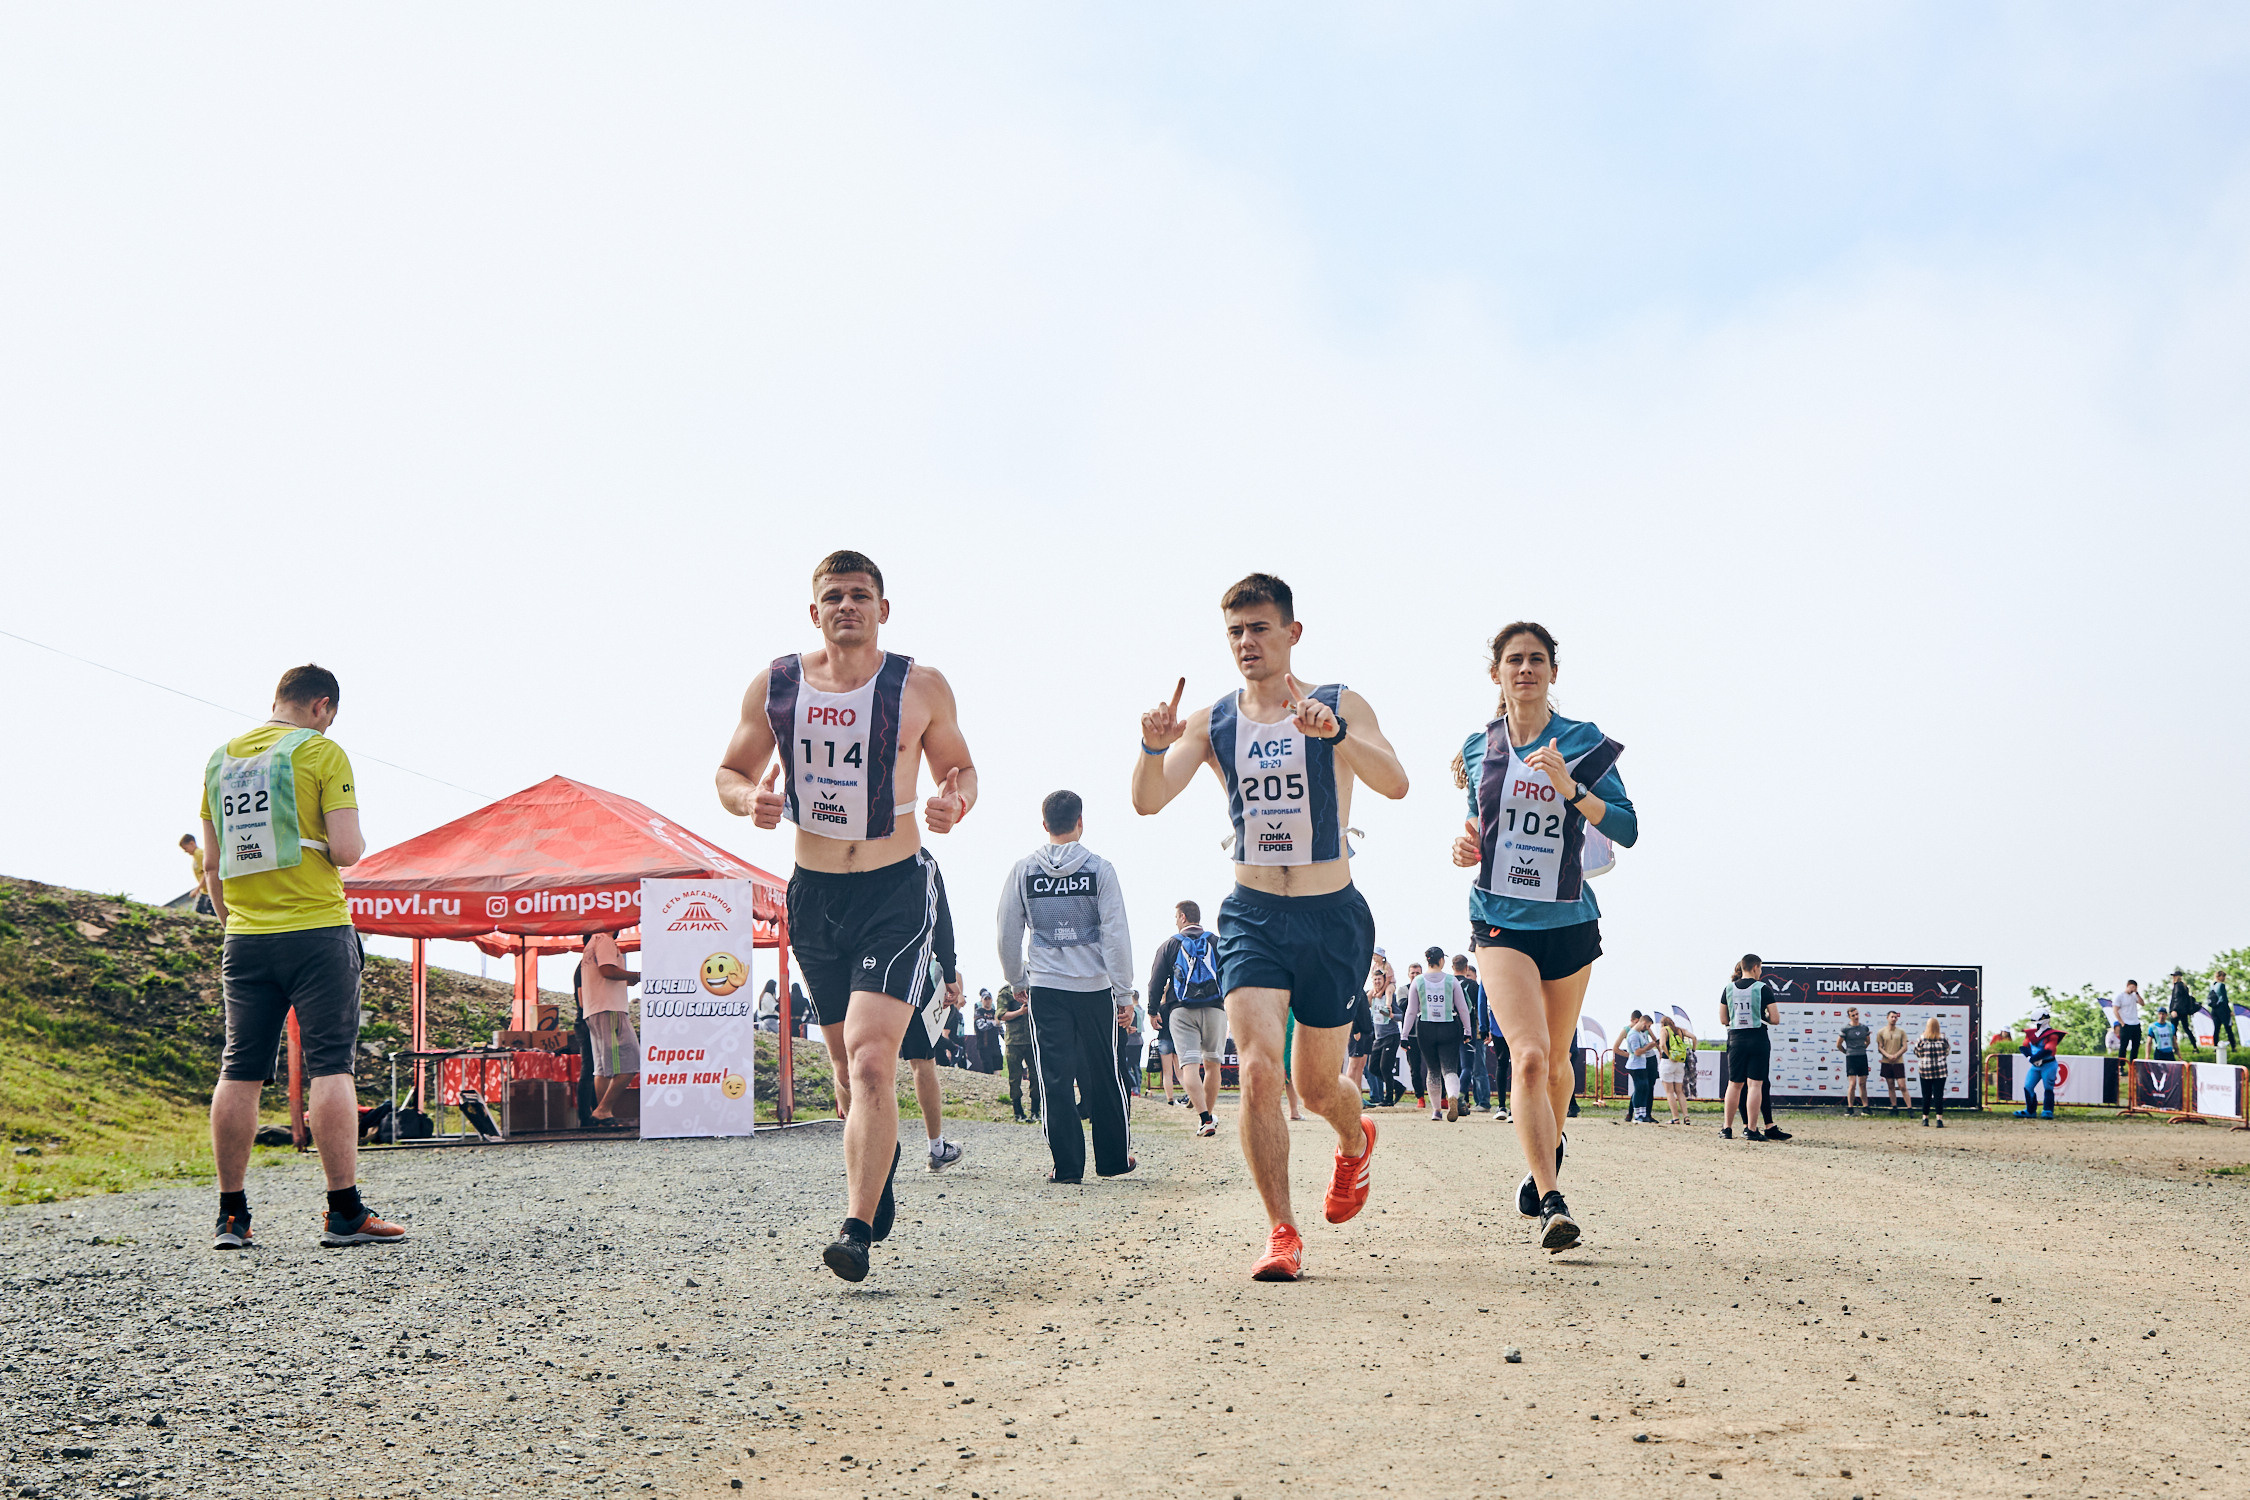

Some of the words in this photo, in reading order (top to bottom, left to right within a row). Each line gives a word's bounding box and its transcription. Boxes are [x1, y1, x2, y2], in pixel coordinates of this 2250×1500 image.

[807, 706, 856, 727] PRO
[801, 739, 862, 768] 114
[1248, 738, 1292, 758] AGE
[817, 776, 858, 787] ГАЗПРОМБАНК
[1242, 774, 1304, 801] 205
[1513, 779, 1556, 802] PRO
[224, 790, 269, 816] 622
[814, 802, 845, 812] ГОНКА
[812, 812, 847, 824] ГЕРОЕВ
[1506, 808, 1560, 838] 102
[1260, 833, 1291, 841] ГОНКА
[237, 843, 260, 852] ГОНКА
[1259, 843, 1293, 852] ГЕРОЕВ
[1516, 843, 1555, 854] ГАЗПРОМБАНК
[237, 852, 263, 861] ГЕРОЕВ
[1510, 865, 1539, 876] ГОНКА
[1033, 876, 1090, 895] СУДЬЯ
[1508, 876, 1540, 887] ГЕРОЕВ
[662, 896, 681, 914] СЕТЬ
[682, 890, 732, 914] МАГАЗИНОВ
[667, 922, 728, 931] ОЛИМП
[644, 979, 697, 994] ХОЧЕШЬ
[1817, 980, 1860, 992] ГОНКА
[1864, 981, 1914, 993] ГЕРОЕВ
[1427, 994, 1445, 1003] 699
[647, 1000, 684, 1017] 1000
[686, 1002, 750, 1017] БОНУСОВ?
[647, 1046, 705, 1065] Спроси
[647, 1073, 687, 1085] меня
[692, 1068, 728, 1084] как!
